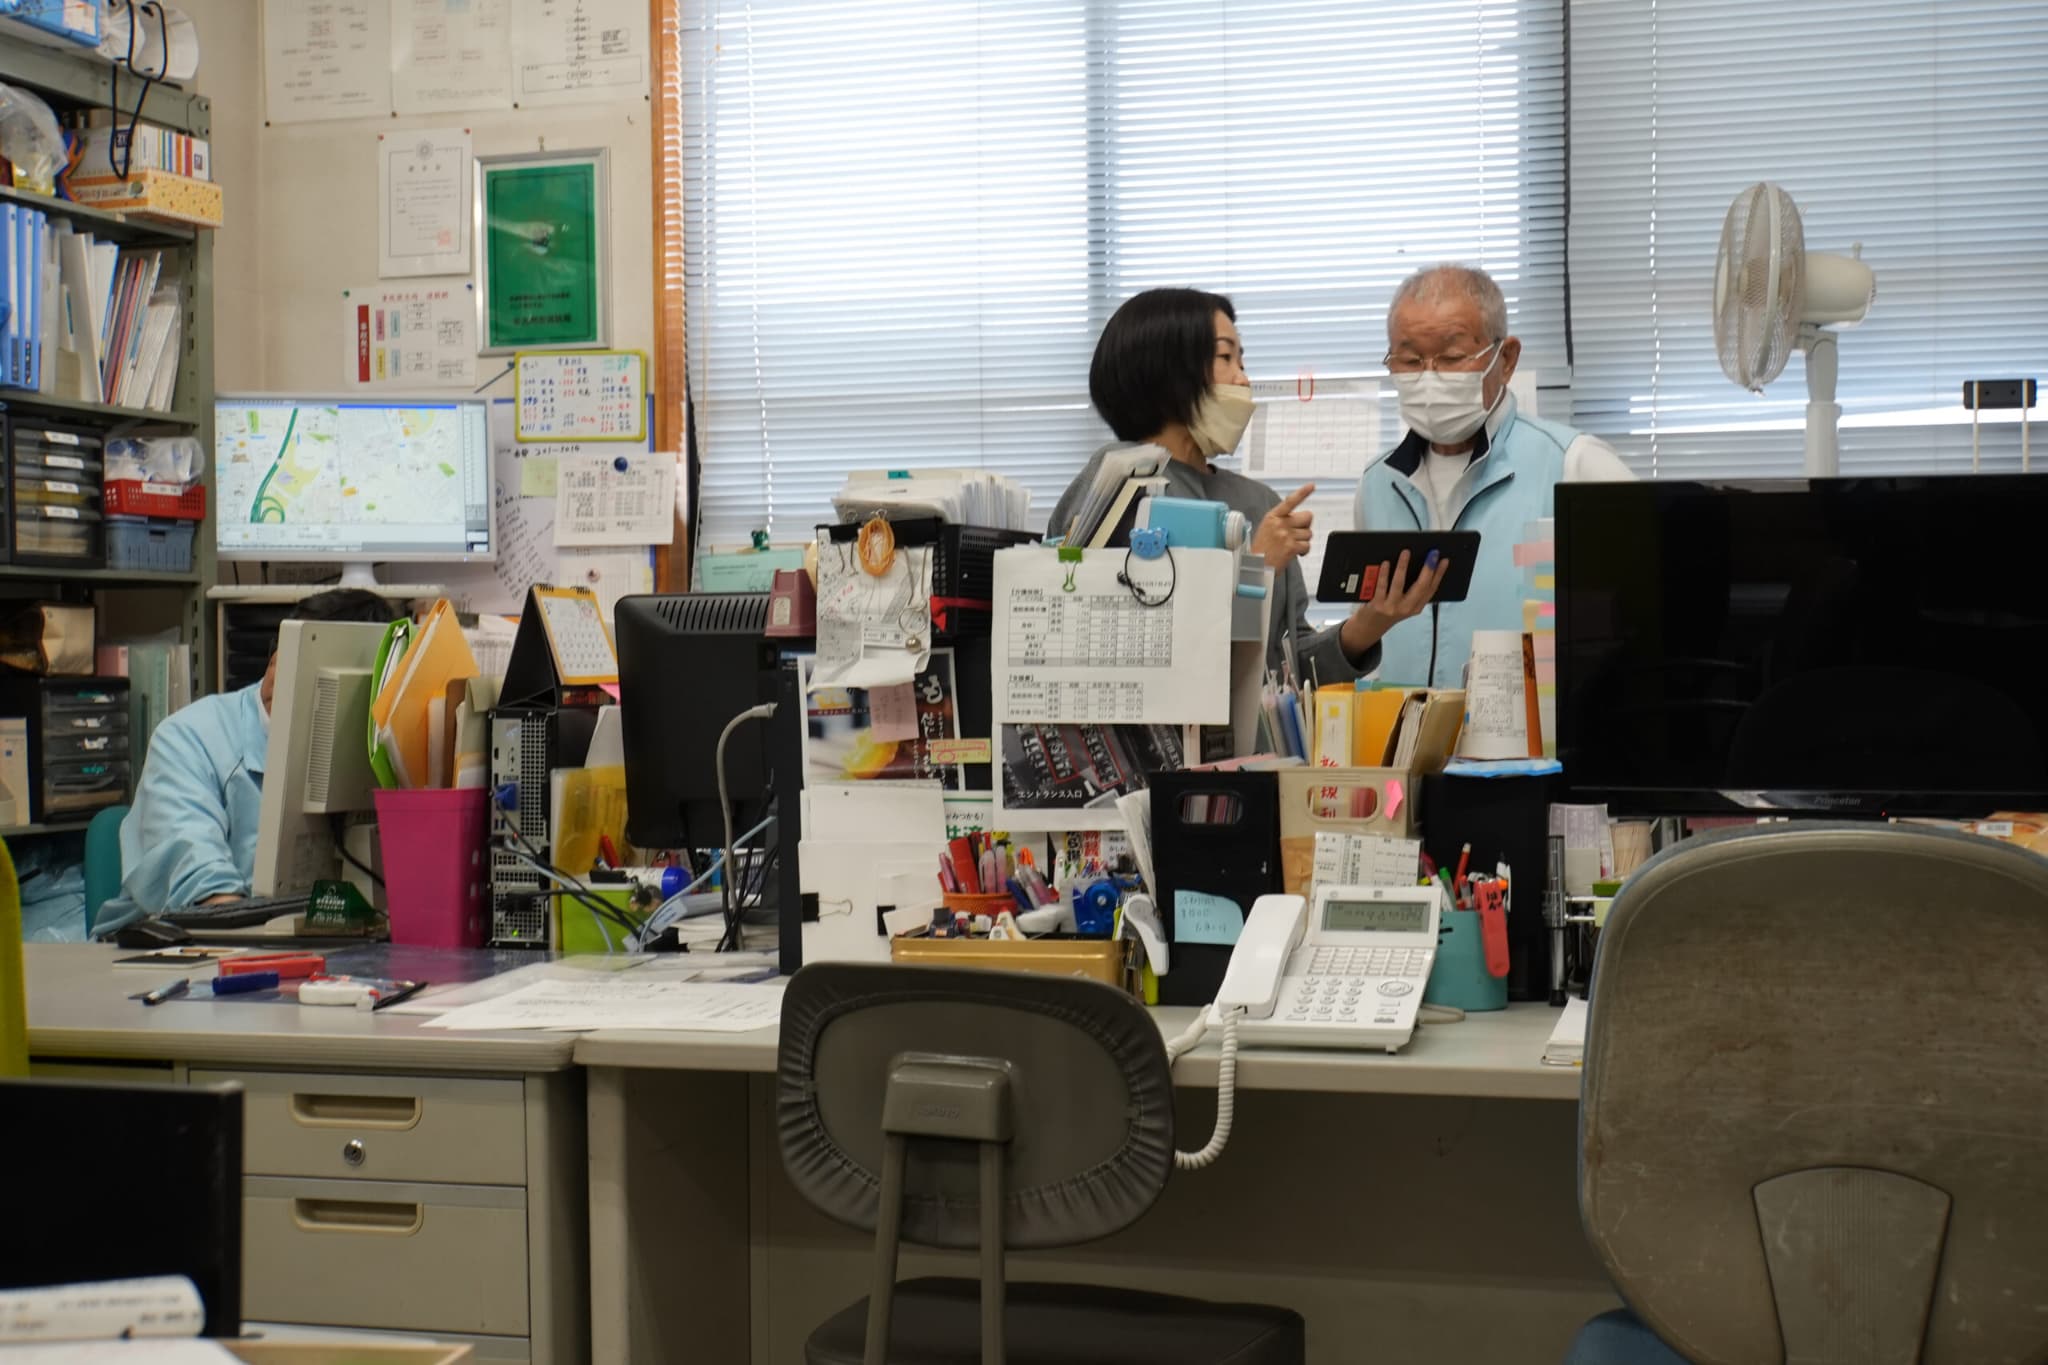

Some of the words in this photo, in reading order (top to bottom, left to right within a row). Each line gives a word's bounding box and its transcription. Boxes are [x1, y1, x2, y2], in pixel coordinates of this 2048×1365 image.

[1018, 789, 1082, 799] エントランス入口
